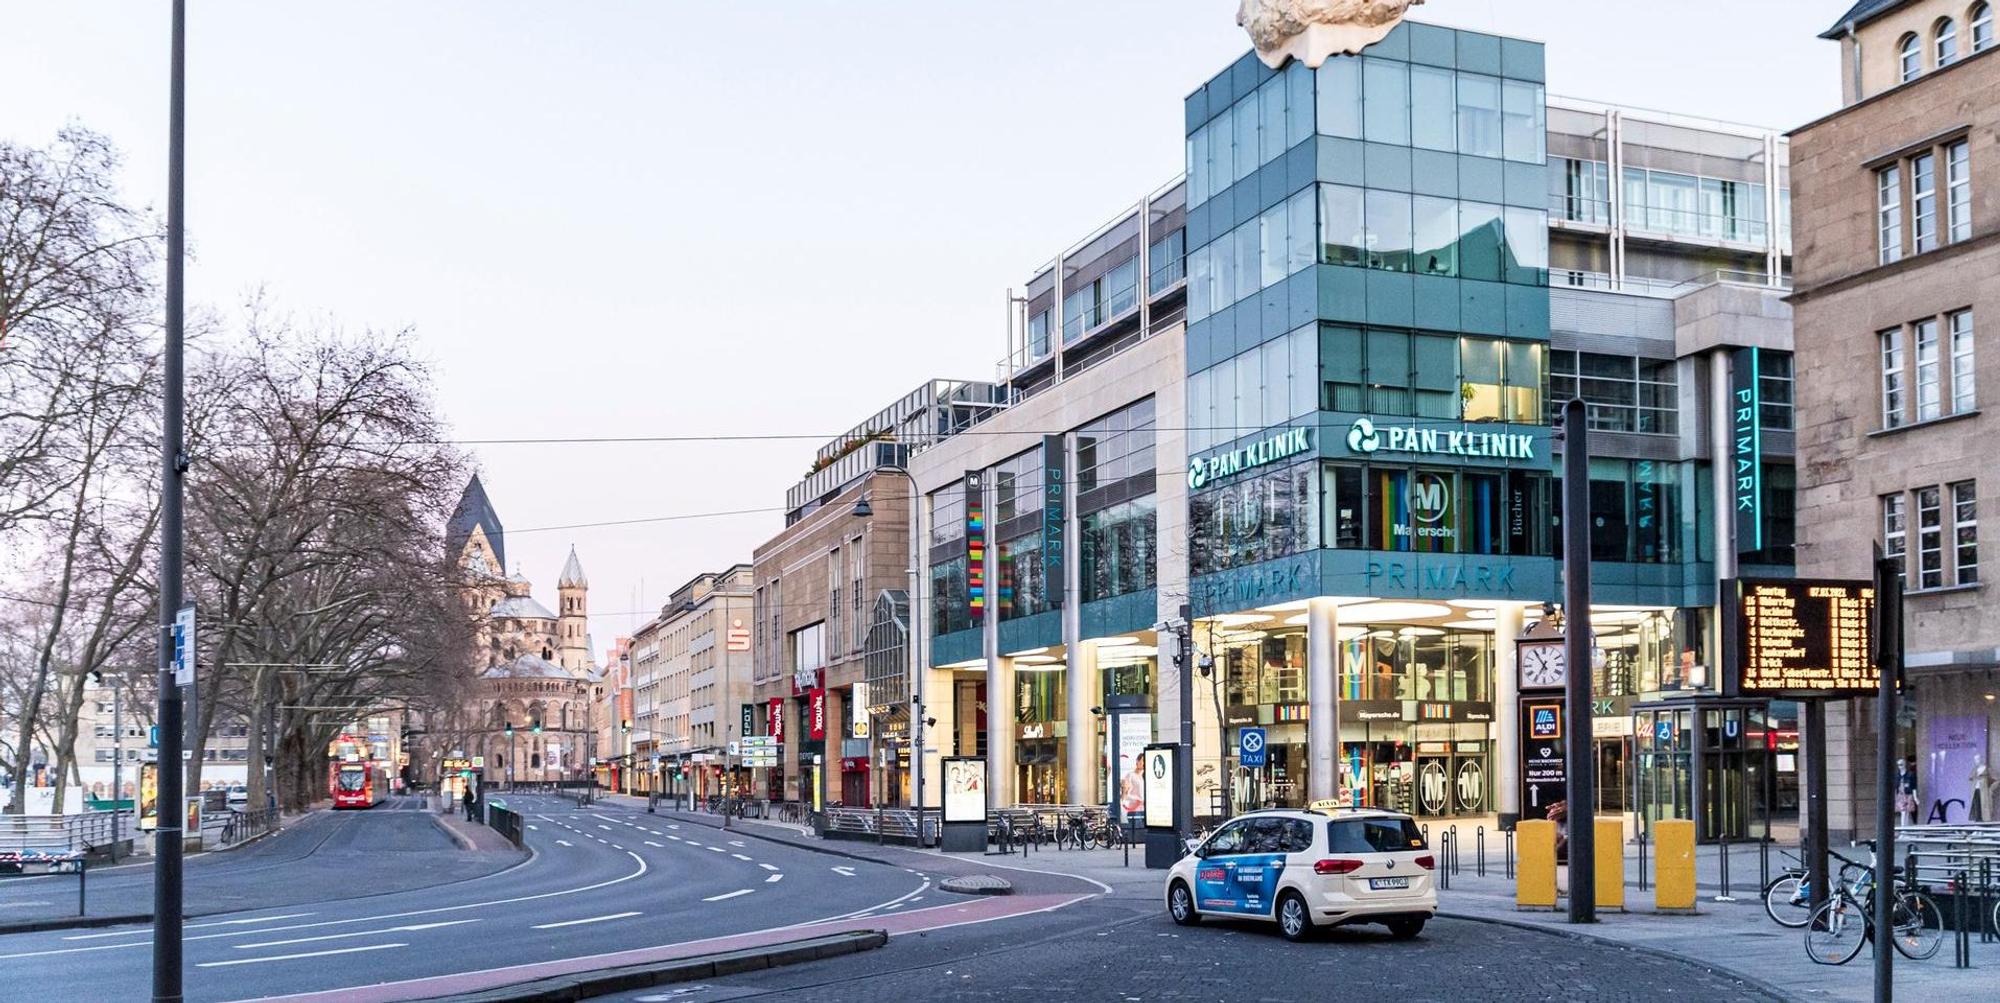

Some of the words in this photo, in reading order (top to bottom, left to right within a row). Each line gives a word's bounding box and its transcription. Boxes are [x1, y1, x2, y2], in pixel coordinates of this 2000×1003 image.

[1210, 451, 1239, 479] PAN
[1246, 427, 1310, 468] KLINIK
[1389, 427, 1437, 454] PAN
[1449, 430, 1534, 460] KLINIK
[1736, 388, 1753, 513] PRIMARK
[1047, 469, 1061, 567] PRIMARK
[1511, 488, 1523, 536] Bücher
[1204, 563, 1302, 604] PRIMARK
[1365, 562, 1516, 593] PRIMARK
[744, 708, 752, 736] EPOT
[1535, 723, 1556, 731] ALDI
[1726, 722, 1738, 737] U
[1242, 755, 1264, 764] TAXI
